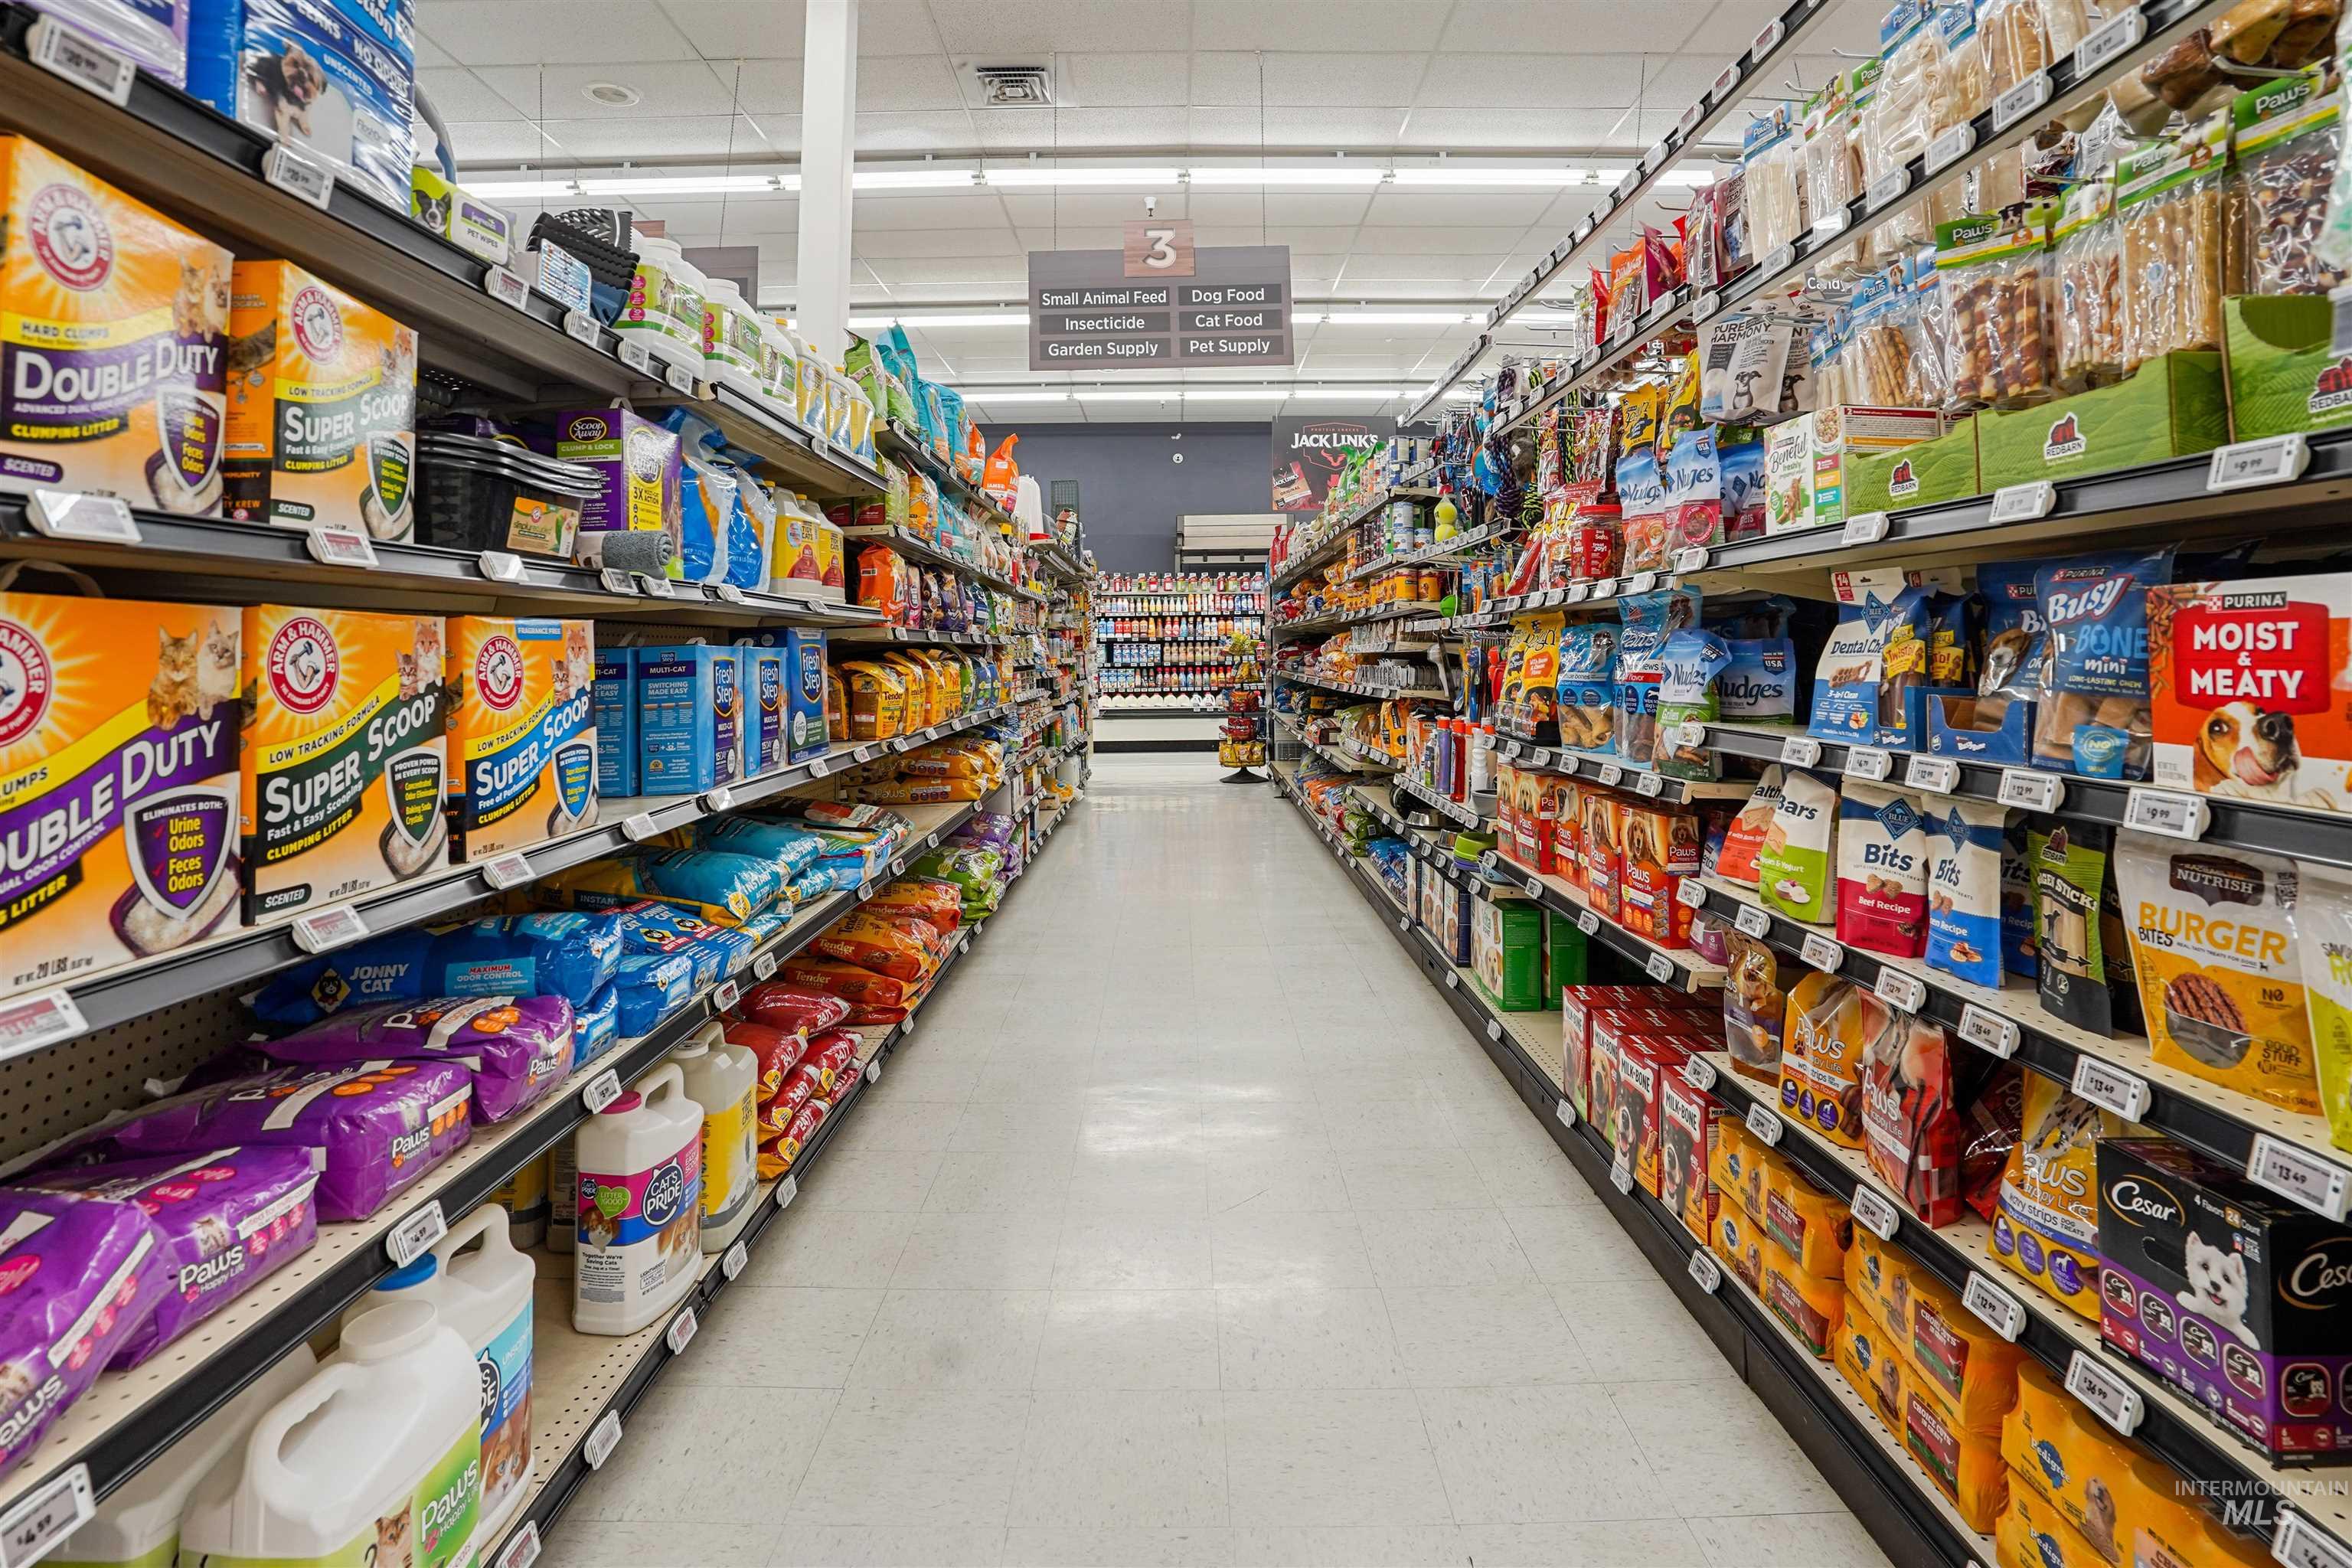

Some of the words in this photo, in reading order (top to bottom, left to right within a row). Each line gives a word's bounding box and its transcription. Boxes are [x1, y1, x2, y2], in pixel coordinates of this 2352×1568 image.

[322, 54, 374, 96] UNSCENTED
[2255, 81, 2311, 113] Paws
[467, 230, 479, 239] PET
[480, 234, 498, 248] WIPES
[1952, 223, 1994, 242] Paws
[1142, 228, 1176, 268] 3
[1042, 292, 1079, 306] Small
[1083, 291, 1130, 305] Animal
[1134, 290, 1167, 304] Feed
[1192, 289, 1222, 305] Dog
[1227, 288, 1264, 302] Food
[1065, 315, 1145, 330] Insecticide
[1195, 315, 1220, 328] Cat
[1225, 313, 1263, 326] Food
[1714, 321, 1746, 335] PURE
[1710, 323, 1771, 343] HARMONY
[1048, 342, 1102, 357] Garden
[1107, 341, 1158, 358] Supply
[1190, 340, 1214, 353] Pet
[1220, 338, 1270, 356] Supply
[13, 351, 152, 403] DOUBLE
[155, 338, 220, 381] DUTY
[284, 405, 354, 442] SUPER
[359, 390, 409, 429] SCOOP
[11, 423, 79, 439] CLUMPING
[81, 418, 119, 436] LITTER
[1291, 433, 1331, 449] JACK
[1332, 433, 1378, 448] LINK'S
[2046, 441, 2083, 457] REDBARN
[285, 459, 323, 471] CLUMPING
[324, 456, 348, 469] LITTER
[1770, 434, 1808, 473] Beneful
[2, 459, 55, 477] SCENTED
[633, 486, 643, 499] 3X
[1891, 480, 1918, 494] REDBARN
[278, 504, 310, 517] SCENTED
[2064, 568, 2105, 579] PURINA
[2047, 576, 2126, 623] Busy
[2223, 593, 2285, 608] PURINA
[518, 626, 547, 636] FRAGRANCE
[547, 626, 561, 635] FREE
[2193, 622, 2299, 651] MOIST
[272, 635, 293, 675] ARM
[299, 622, 338, 675] HAMMER
[1831, 640, 1866, 655] Dental
[802, 652, 820, 670] Fresh
[1764, 659, 1783, 668] USA
[2084, 656, 2126, 674] mini
[2237, 652, 2252, 666] &
[649, 666, 686, 675] MULTI-CAT
[715, 665, 734, 684] Fresh
[761, 665, 779, 683] Fresh
[2069, 675, 2116, 686] LONG-LASTING
[648, 681, 688, 690] SWITCHING
[805, 671, 821, 691] Step
[2190, 668, 2303, 699] MEATY
[717, 686, 733, 705] Step
[763, 684, 779, 701] Step
[270, 749, 296, 764] LOW
[299, 725, 345, 756] TRACKING
[345, 695, 381, 735] FORMULA
[477, 740, 495, 752] LOW
[497, 717, 527, 743] TRACKING
[527, 697, 552, 727] FORMULA
[121, 720, 222, 802] DUTY
[394, 760, 417, 772] PROVEN
[417, 758, 439, 768] POWER
[475, 743, 539, 796] SUPER
[264, 751, 362, 823] SUPER
[142, 803, 195, 822] ELIMINATES
[197, 801, 224, 812] BOTH:
[267, 823, 292, 841] Fast
[293, 819, 302, 831] &
[303, 804, 326, 831] Easy
[325, 779, 364, 820] Scooping
[478, 799, 511, 825] CLUMPING
[511, 783, 536, 811] LITTER
[168, 818, 201, 835] Urine
[1888, 812, 1910, 824] BLUE
[168, 833, 204, 853] Odors
[266, 832, 322, 861] CLUMPING
[322, 809, 354, 841] LITTER
[24, 854, 58, 880] ODOR
[57, 822, 107, 861] CONTROL
[1591, 845, 1606, 865] Paws
[1669, 846, 1696, 858] Paws
[1864, 843, 1913, 872] Bits
[168, 859, 201, 876] Feces
[1627, 861, 1650, 883] Paws
[1935, 858, 1961, 887] Bits
[168, 874, 204, 894] Odors
[2176, 869, 2255, 895] NUTRISH
[10, 875, 69, 920] LITTER
[265, 888, 305, 908] SCENTED
[1858, 895, 1874, 907] Beef
[1876, 899, 1911, 916] Recipe
[2138, 901, 2288, 965] BURGER
[2138, 926, 2174, 948] BITES
[818, 938, 855, 954] Tender
[352, 963, 409, 978] JONNY
[457, 973, 481, 982] ODOR
[483, 971, 523, 979] CONTROL
[469, 965, 512, 974] MAXIMUM
[795, 970, 831, 984] Tender
[361, 978, 394, 993] CAT
[391, 1122, 430, 1159] Paws
[651, 1170, 678, 1196] CAT'S
[647, 1180, 681, 1215] PRIDE
[2111, 1181, 2177, 1221] Cesar
[2027, 1204, 2058, 1225] strips
[2194, 1194, 2202, 1205] 4
[2202, 1198, 2225, 1218] Flavors
[2226, 1209, 2240, 1224] 24
[2241, 1217, 2261, 1236] Count
[178, 1242, 244, 1289] Paws
[419, 1458, 479, 1541] Paws
